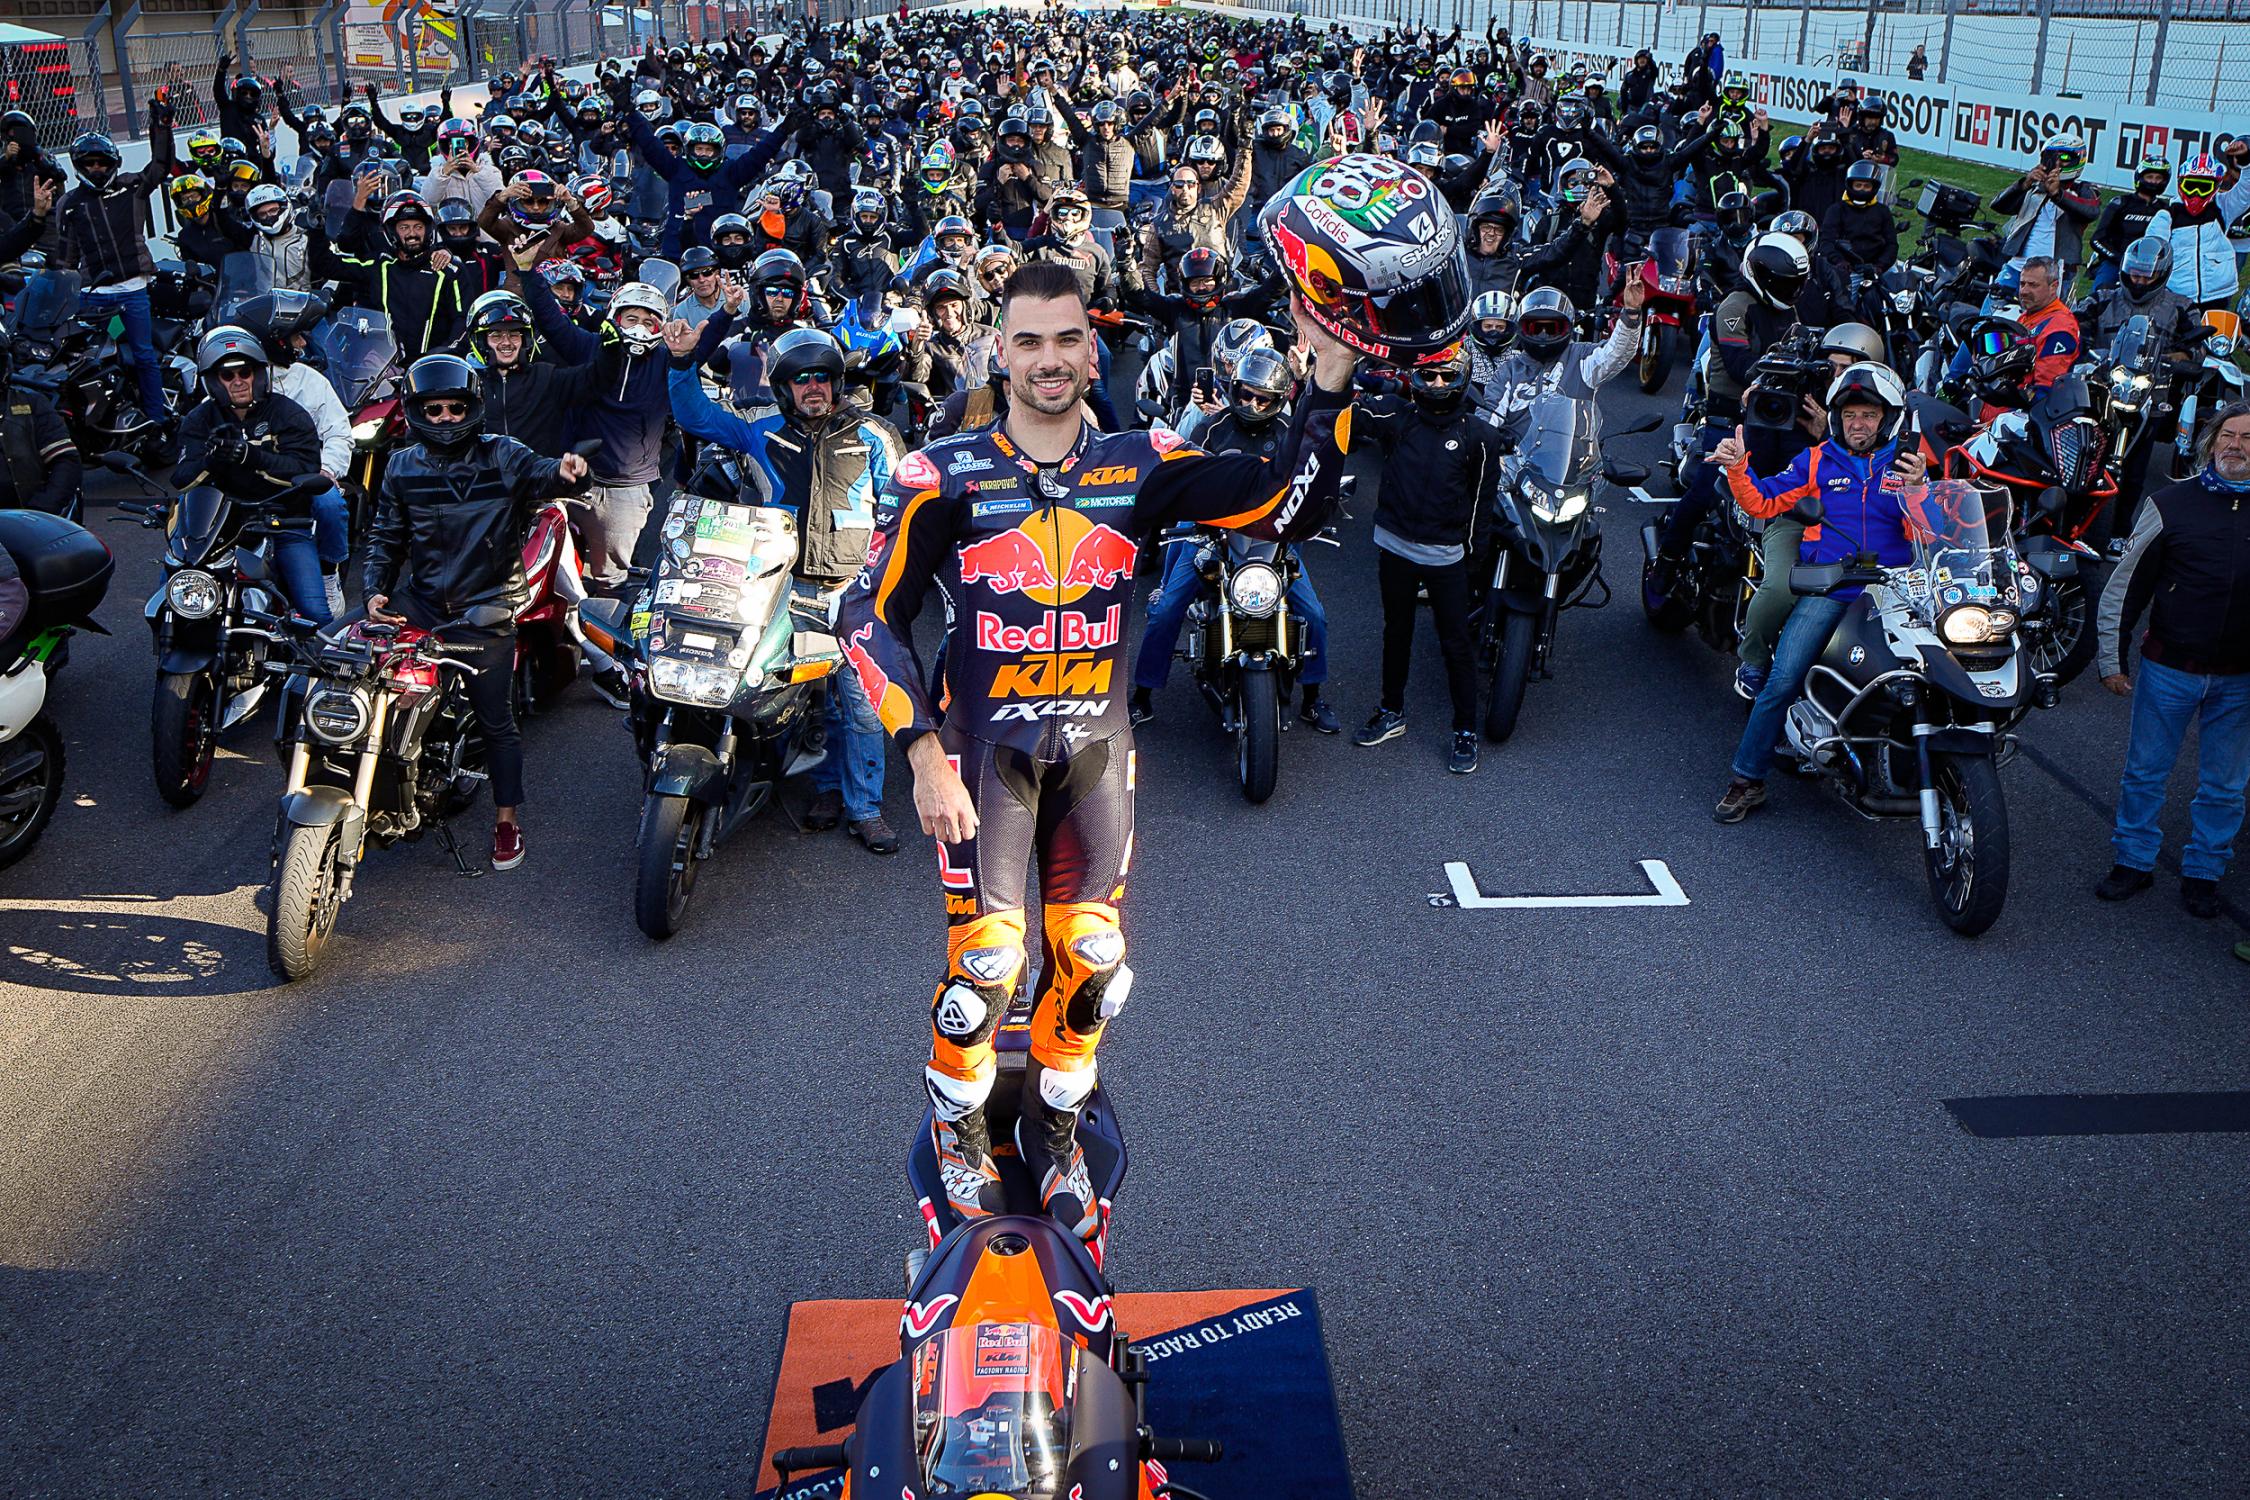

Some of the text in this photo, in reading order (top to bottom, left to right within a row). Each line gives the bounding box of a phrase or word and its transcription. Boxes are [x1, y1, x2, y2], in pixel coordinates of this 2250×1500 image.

[1304, 200, 1349, 244] Cofidis
[1401, 223, 1451, 267] SHARK
[1387, 260, 1448, 296] GIVES YOU
[1341, 288, 1369, 297] SHARK
[856, 331, 880, 341] SUZUKI
[1301, 294, 1390, 359] Red Bull
[991, 432, 1016, 457] KTM
[948, 458, 994, 475] SHARK
[1078, 465, 1137, 486] KTM
[990, 502, 1027, 510] MICHELIN
[1090, 496, 1134, 507] MOTOREX
[977, 603, 1121, 653] Red Bull
[680, 648, 714, 658] HONDA
[988, 652, 1113, 697] KTM
[945, 892, 976, 914] TM
[979, 1335, 1028, 1347] Red Bull
[1143, 1301, 1302, 1363] READY TO RACE
[985, 1353, 1022, 1361] KTM
[976, 1366, 1028, 1374] FACTORY RACING
